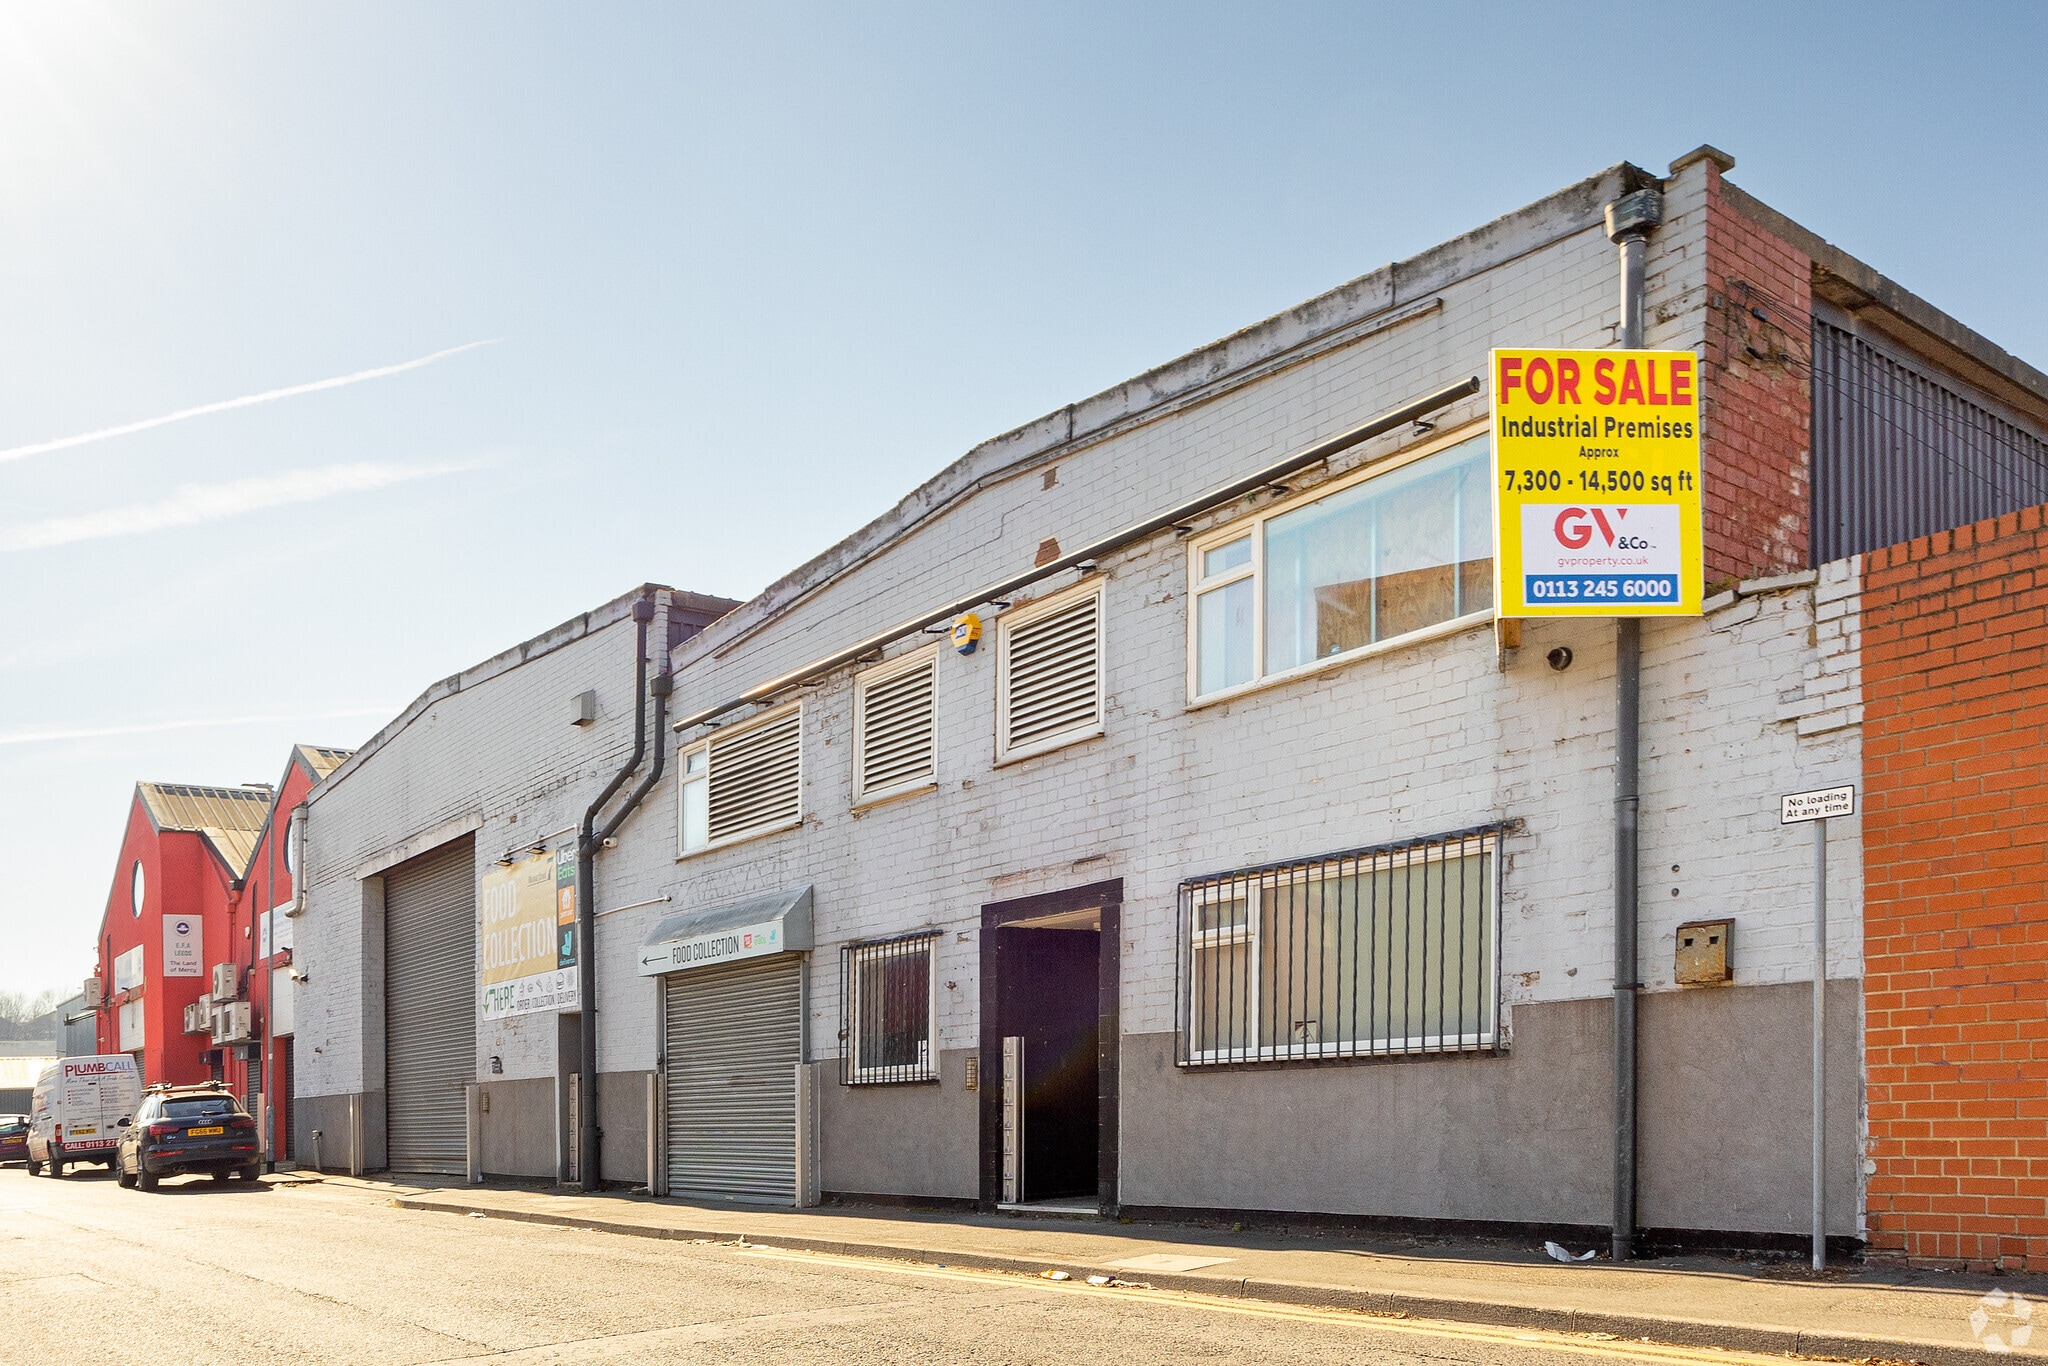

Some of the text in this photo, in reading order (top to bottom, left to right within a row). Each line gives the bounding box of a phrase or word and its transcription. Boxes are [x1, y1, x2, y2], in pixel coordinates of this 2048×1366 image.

[1500, 356, 1692, 406] FOR SALE
[1502, 414, 1693, 438] Industrial Premises
[1579, 445, 1619, 460] Approx
[1504, 470, 1561, 494] 7,300
[1579, 470, 1645, 494] 14,500
[1650, 474, 1673, 496] sq
[1678, 471, 1693, 491] ft
[1553, 506, 1649, 550] GV &Co
[1557, 555, 1649, 568] gvproperty.co.uk
[1532, 579, 1672, 598] 0113 245 6000
[1785, 803, 1849, 818] At any time
[1788, 793, 1847, 807] No loading
[557, 865, 576, 880] Eats
[484, 880, 516, 927] FOOD
[483, 916, 556, 970] COLLECTION
[672, 944, 692, 964] FOOD
[693, 935, 740, 961] COLLECTION
[493, 985, 515, 1011] HERE
[517, 990, 577, 1011] ORDER COLLECTION DELIVERY
[64, 1142, 85, 1150] CALL:
[86, 1140, 104, 1149] 0113
